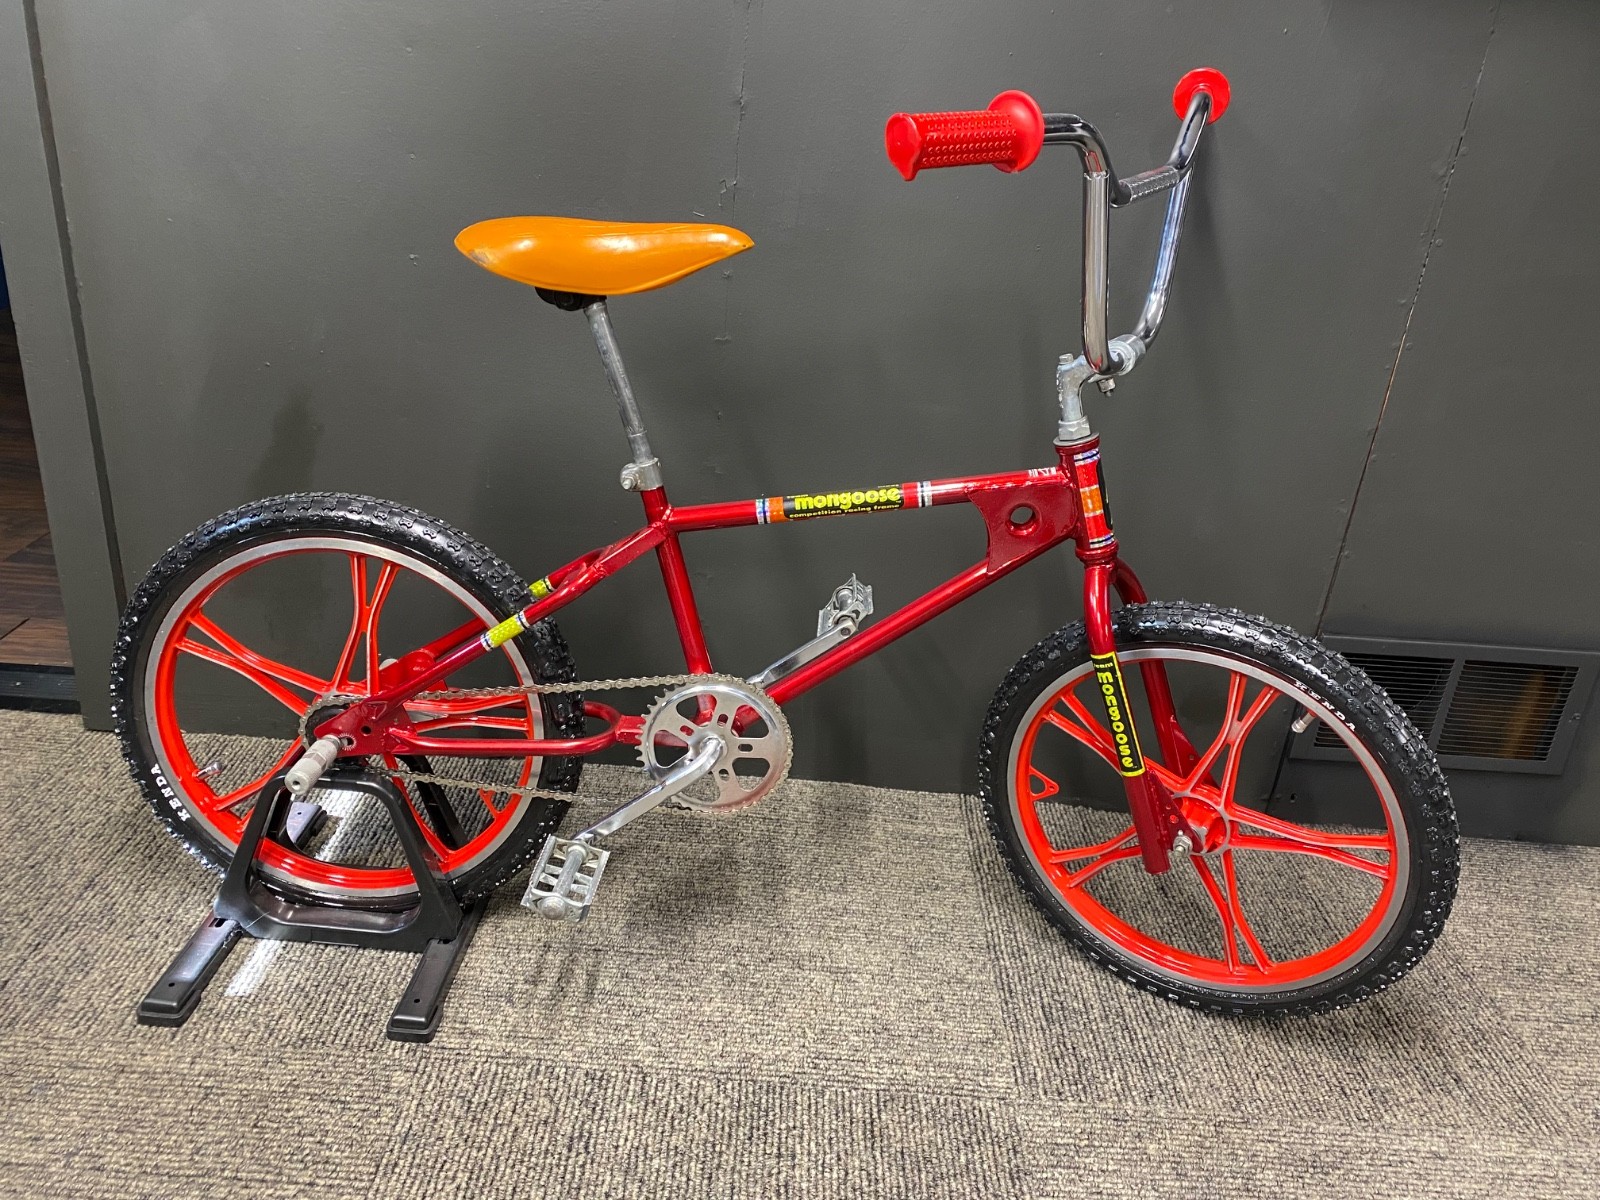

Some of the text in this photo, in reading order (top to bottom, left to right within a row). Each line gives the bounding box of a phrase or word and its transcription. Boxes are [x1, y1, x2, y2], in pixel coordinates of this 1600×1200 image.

[789, 509, 842, 518] competition
[844, 505, 872, 514] racing
[794, 487, 901, 511] mongoose
[1096, 671, 1134, 767] mongoose
[1294, 679, 1356, 732] KENDA
[150, 763, 191, 822] KENDA
